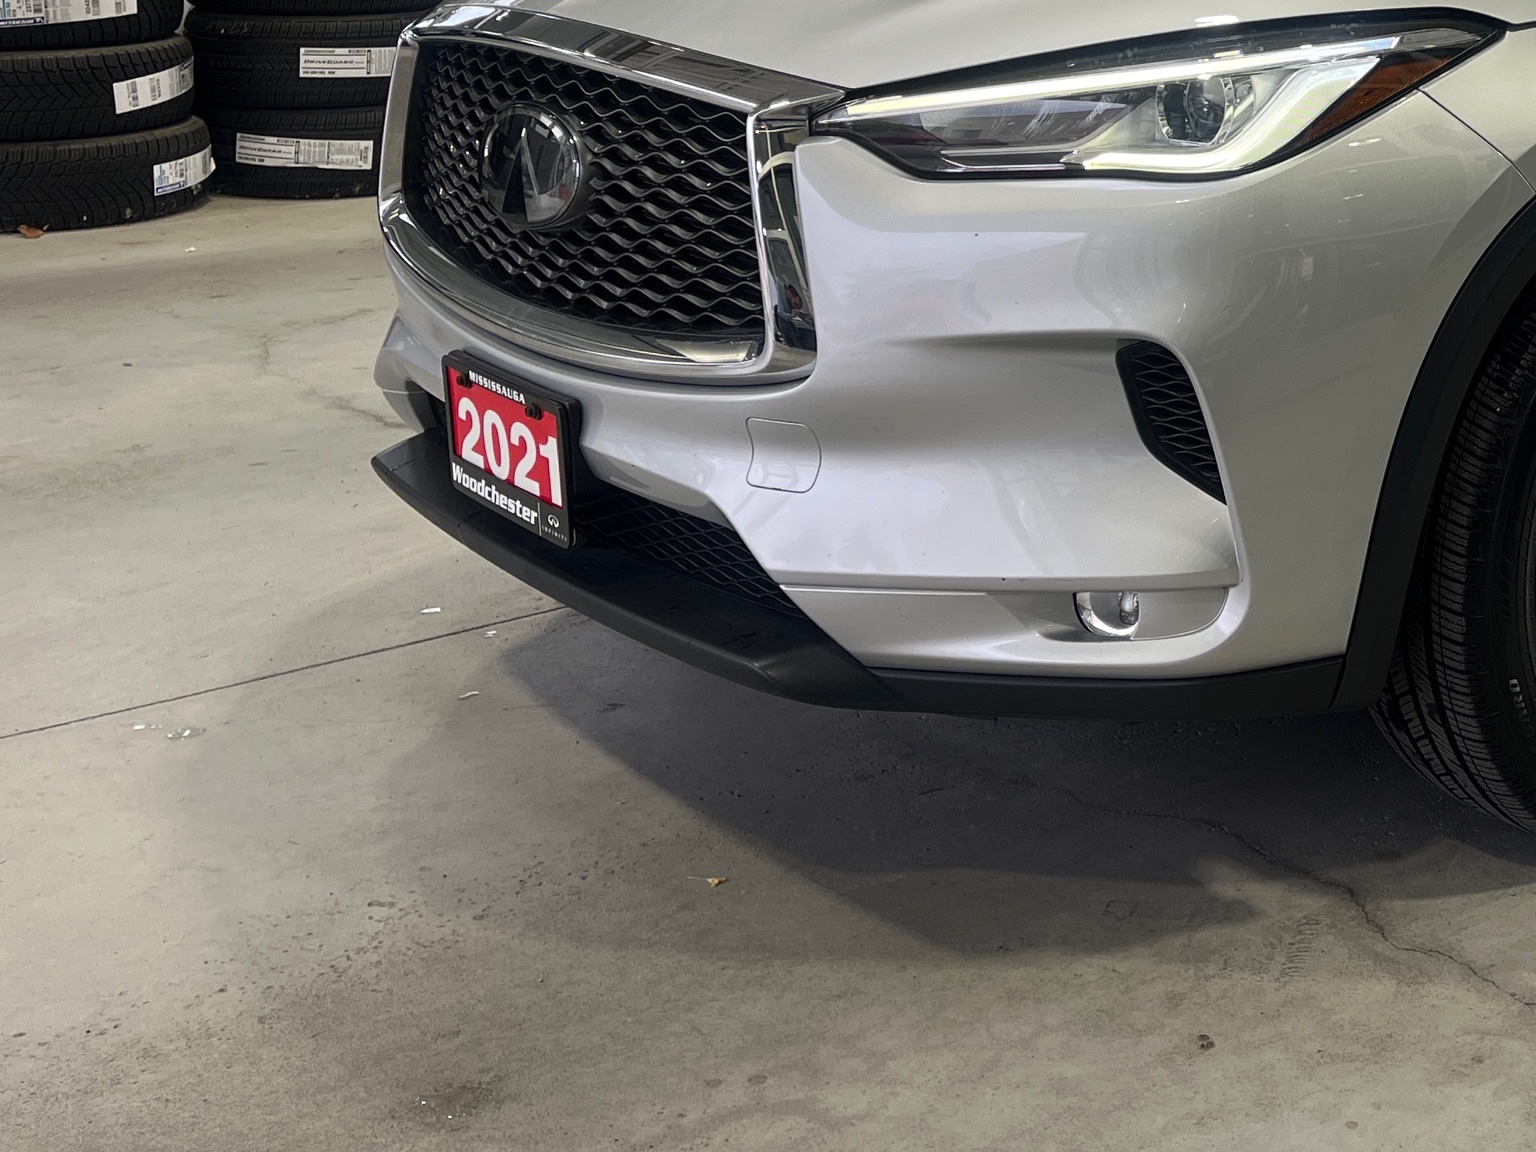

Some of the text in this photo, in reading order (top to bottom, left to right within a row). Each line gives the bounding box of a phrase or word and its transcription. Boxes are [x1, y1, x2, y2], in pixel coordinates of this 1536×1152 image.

[468, 370, 526, 405] MISSISSAUGA
[457, 396, 563, 507] 2021
[451, 461, 538, 525] Woodchester
